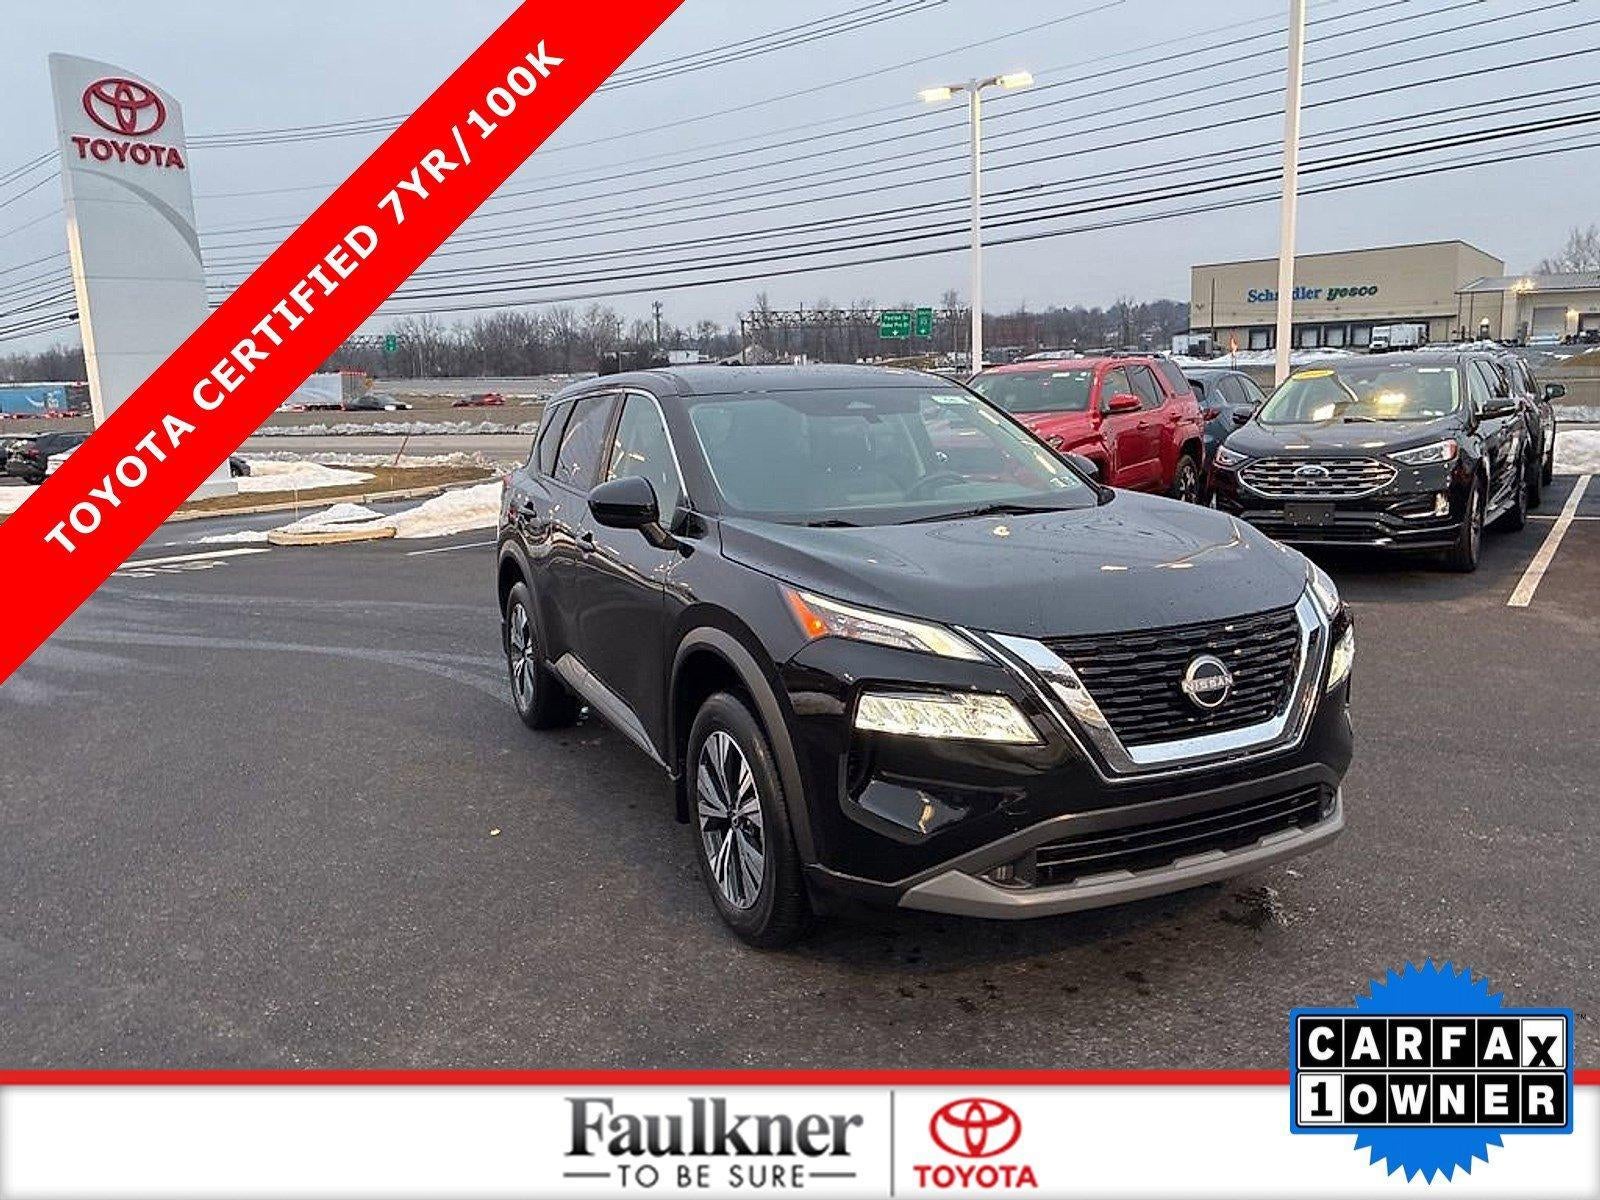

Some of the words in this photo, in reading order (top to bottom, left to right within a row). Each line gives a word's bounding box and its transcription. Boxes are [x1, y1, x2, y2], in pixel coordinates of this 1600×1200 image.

[71, 136, 185, 169] TOYOTA
[1247, 286, 1322, 302] Schdler
[1182, 672, 1233, 693] NISSAN
